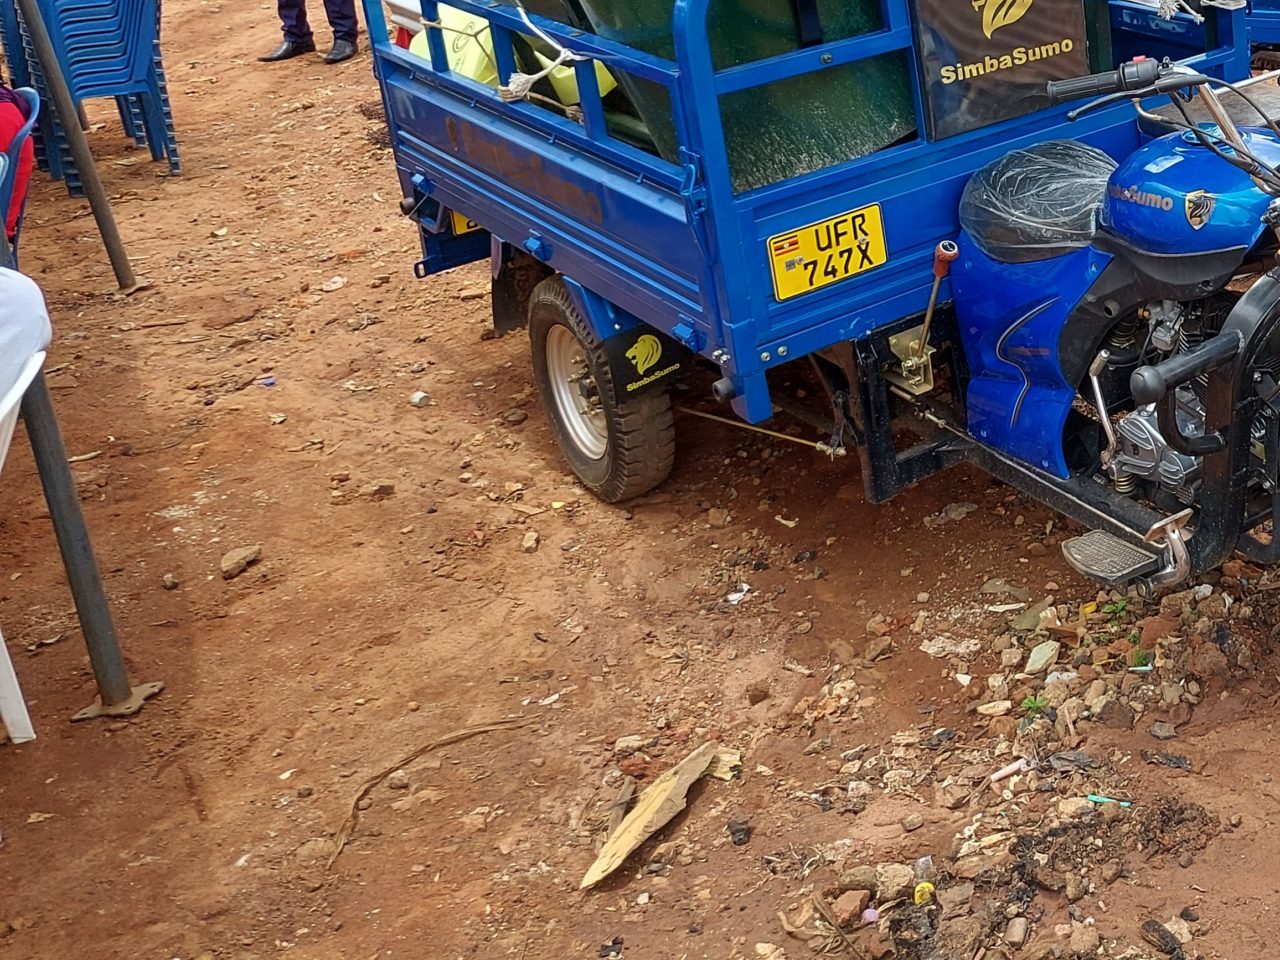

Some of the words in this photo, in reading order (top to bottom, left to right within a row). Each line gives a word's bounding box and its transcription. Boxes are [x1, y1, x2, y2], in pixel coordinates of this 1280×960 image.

[940, 39, 1074, 84] SimbaSumo
[814, 213, 869, 252] UFR
[803, 241, 874, 287] 747X
[626, 363, 681, 392] SimbaSumo
